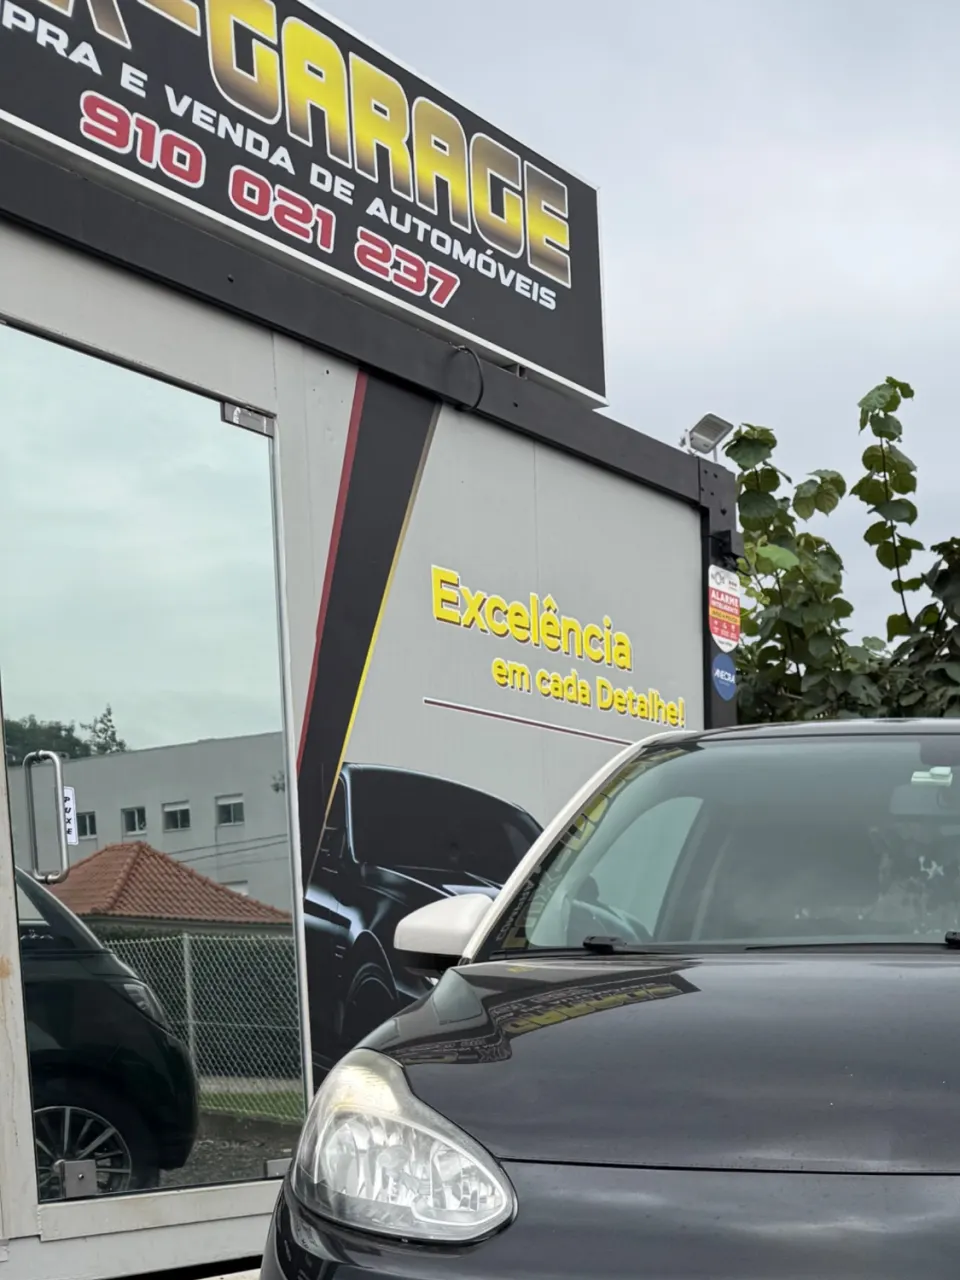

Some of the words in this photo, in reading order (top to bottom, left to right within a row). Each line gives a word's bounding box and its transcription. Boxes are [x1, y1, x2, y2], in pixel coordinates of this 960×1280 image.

[80, 90, 206, 188] 910
[228, 165, 336, 254] 021
[354, 226, 460, 308] 237
[120, 62, 148, 98] E
[165, 84, 295, 175] VENDA
[310, 163, 355, 205] DE
[366, 197, 556, 310] AUTOMÓVEIS
[431, 564, 632, 671] Excelência
[491, 658, 531, 693] em
[536, 668, 591, 708] cada
[596, 676, 686, 727] Detalhe!
